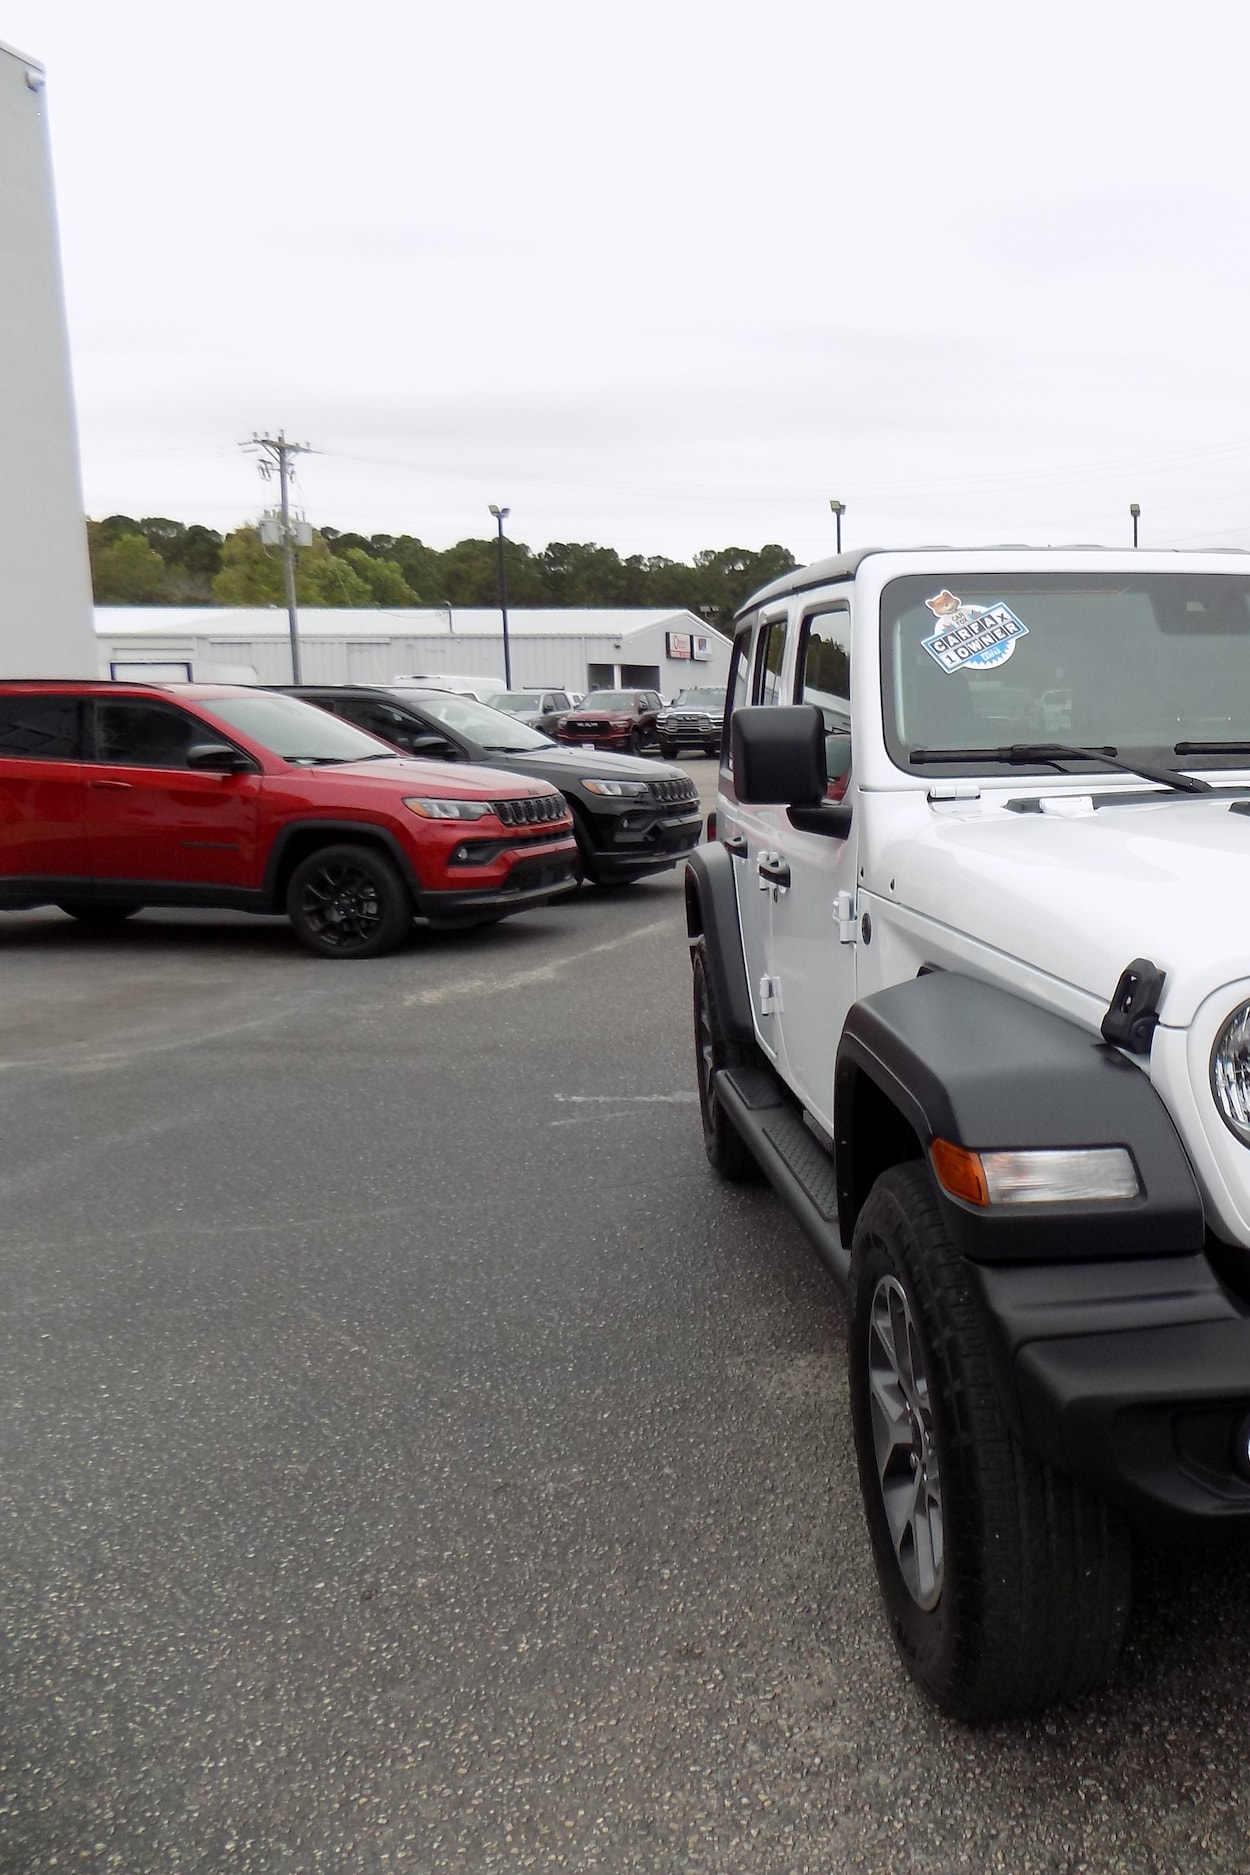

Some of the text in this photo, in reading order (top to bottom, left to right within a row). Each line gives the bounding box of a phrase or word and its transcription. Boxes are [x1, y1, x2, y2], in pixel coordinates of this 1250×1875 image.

[932, 612, 1009, 653] CARFAX
[944, 654, 957, 665] 1
[957, 622, 1019, 659] OWNER
